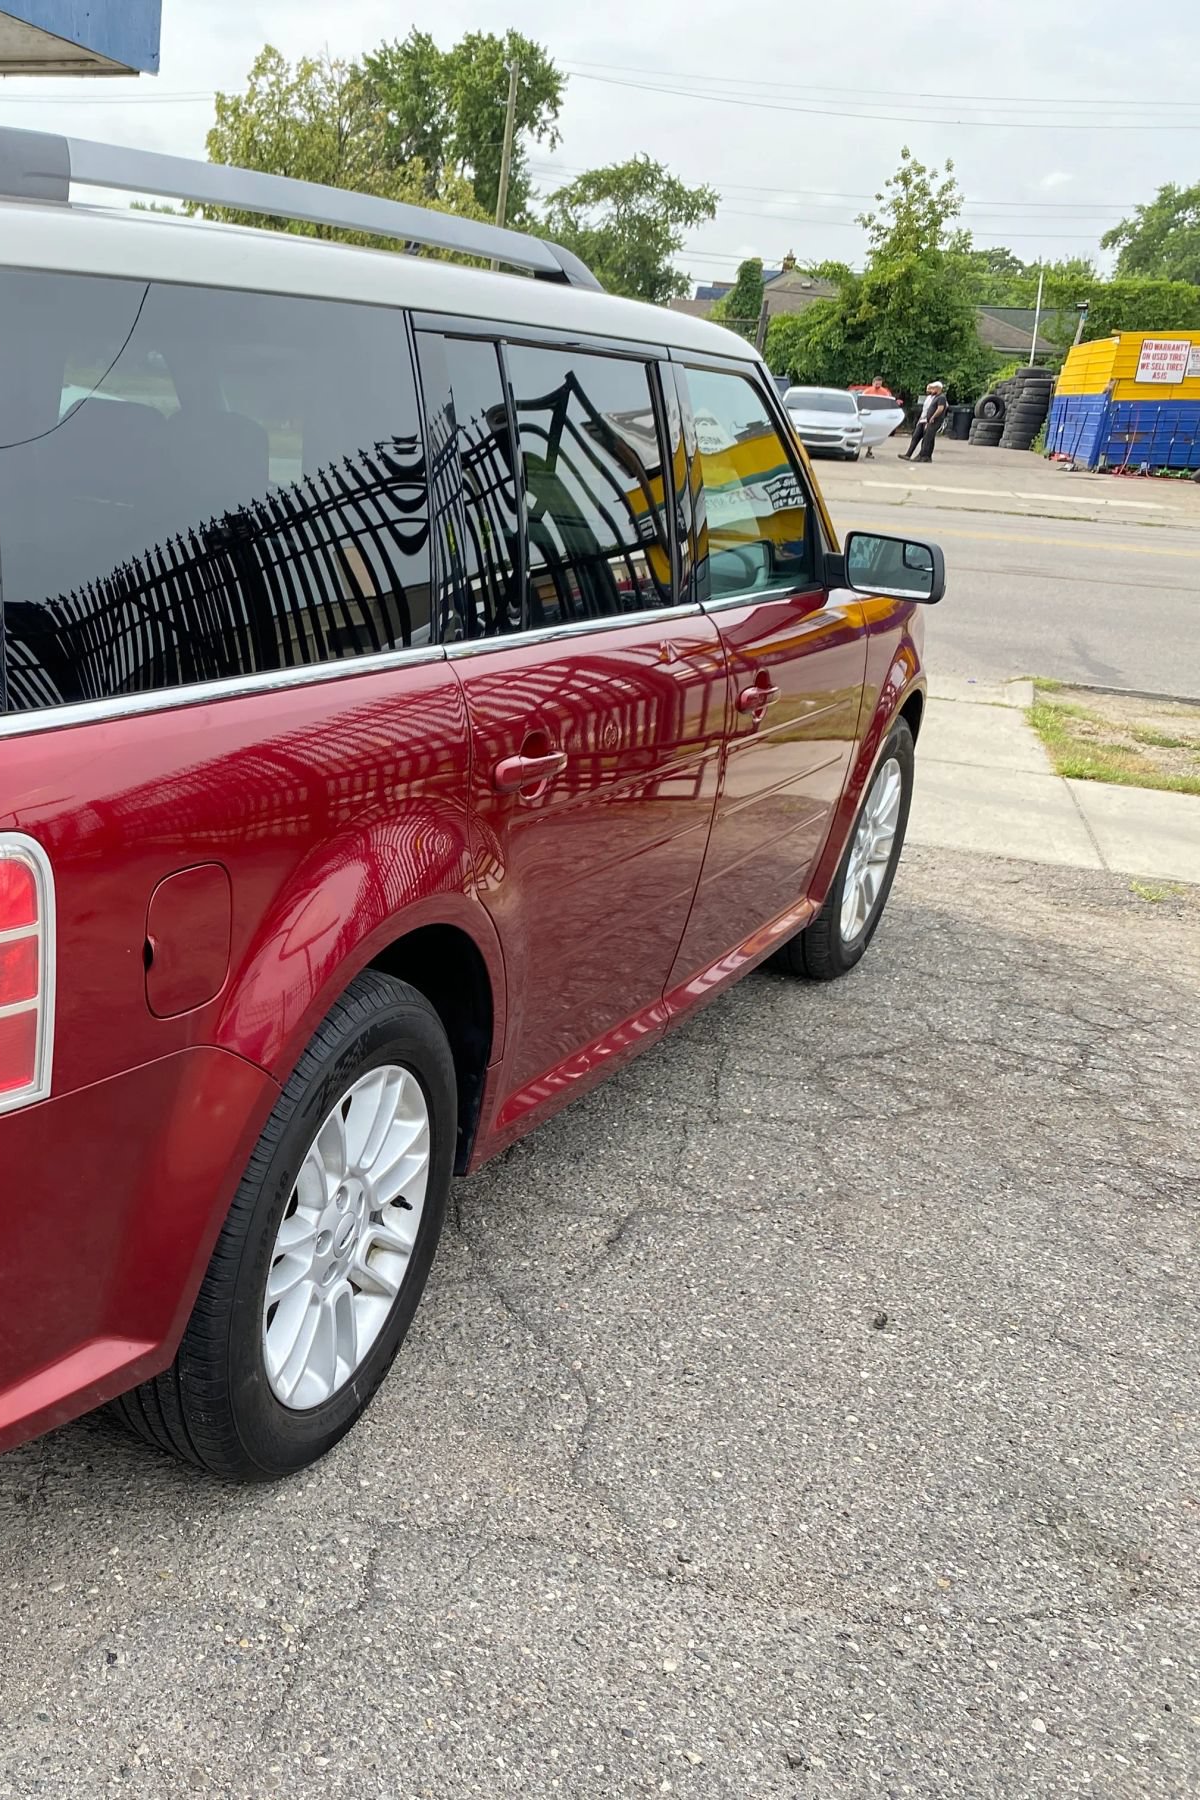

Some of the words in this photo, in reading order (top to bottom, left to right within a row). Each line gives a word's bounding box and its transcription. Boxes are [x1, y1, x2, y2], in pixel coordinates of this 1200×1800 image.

[1143, 342, 1153, 350] NO
[1154, 343, 1188, 351] WARRANTY
[1142, 352, 1150, 360] ON
[1151, 353, 1168, 361] USED
[1169, 353, 1186, 361] TIRES
[1140, 362, 1150, 370] WE
[1166, 363, 1184, 371] TIRES
